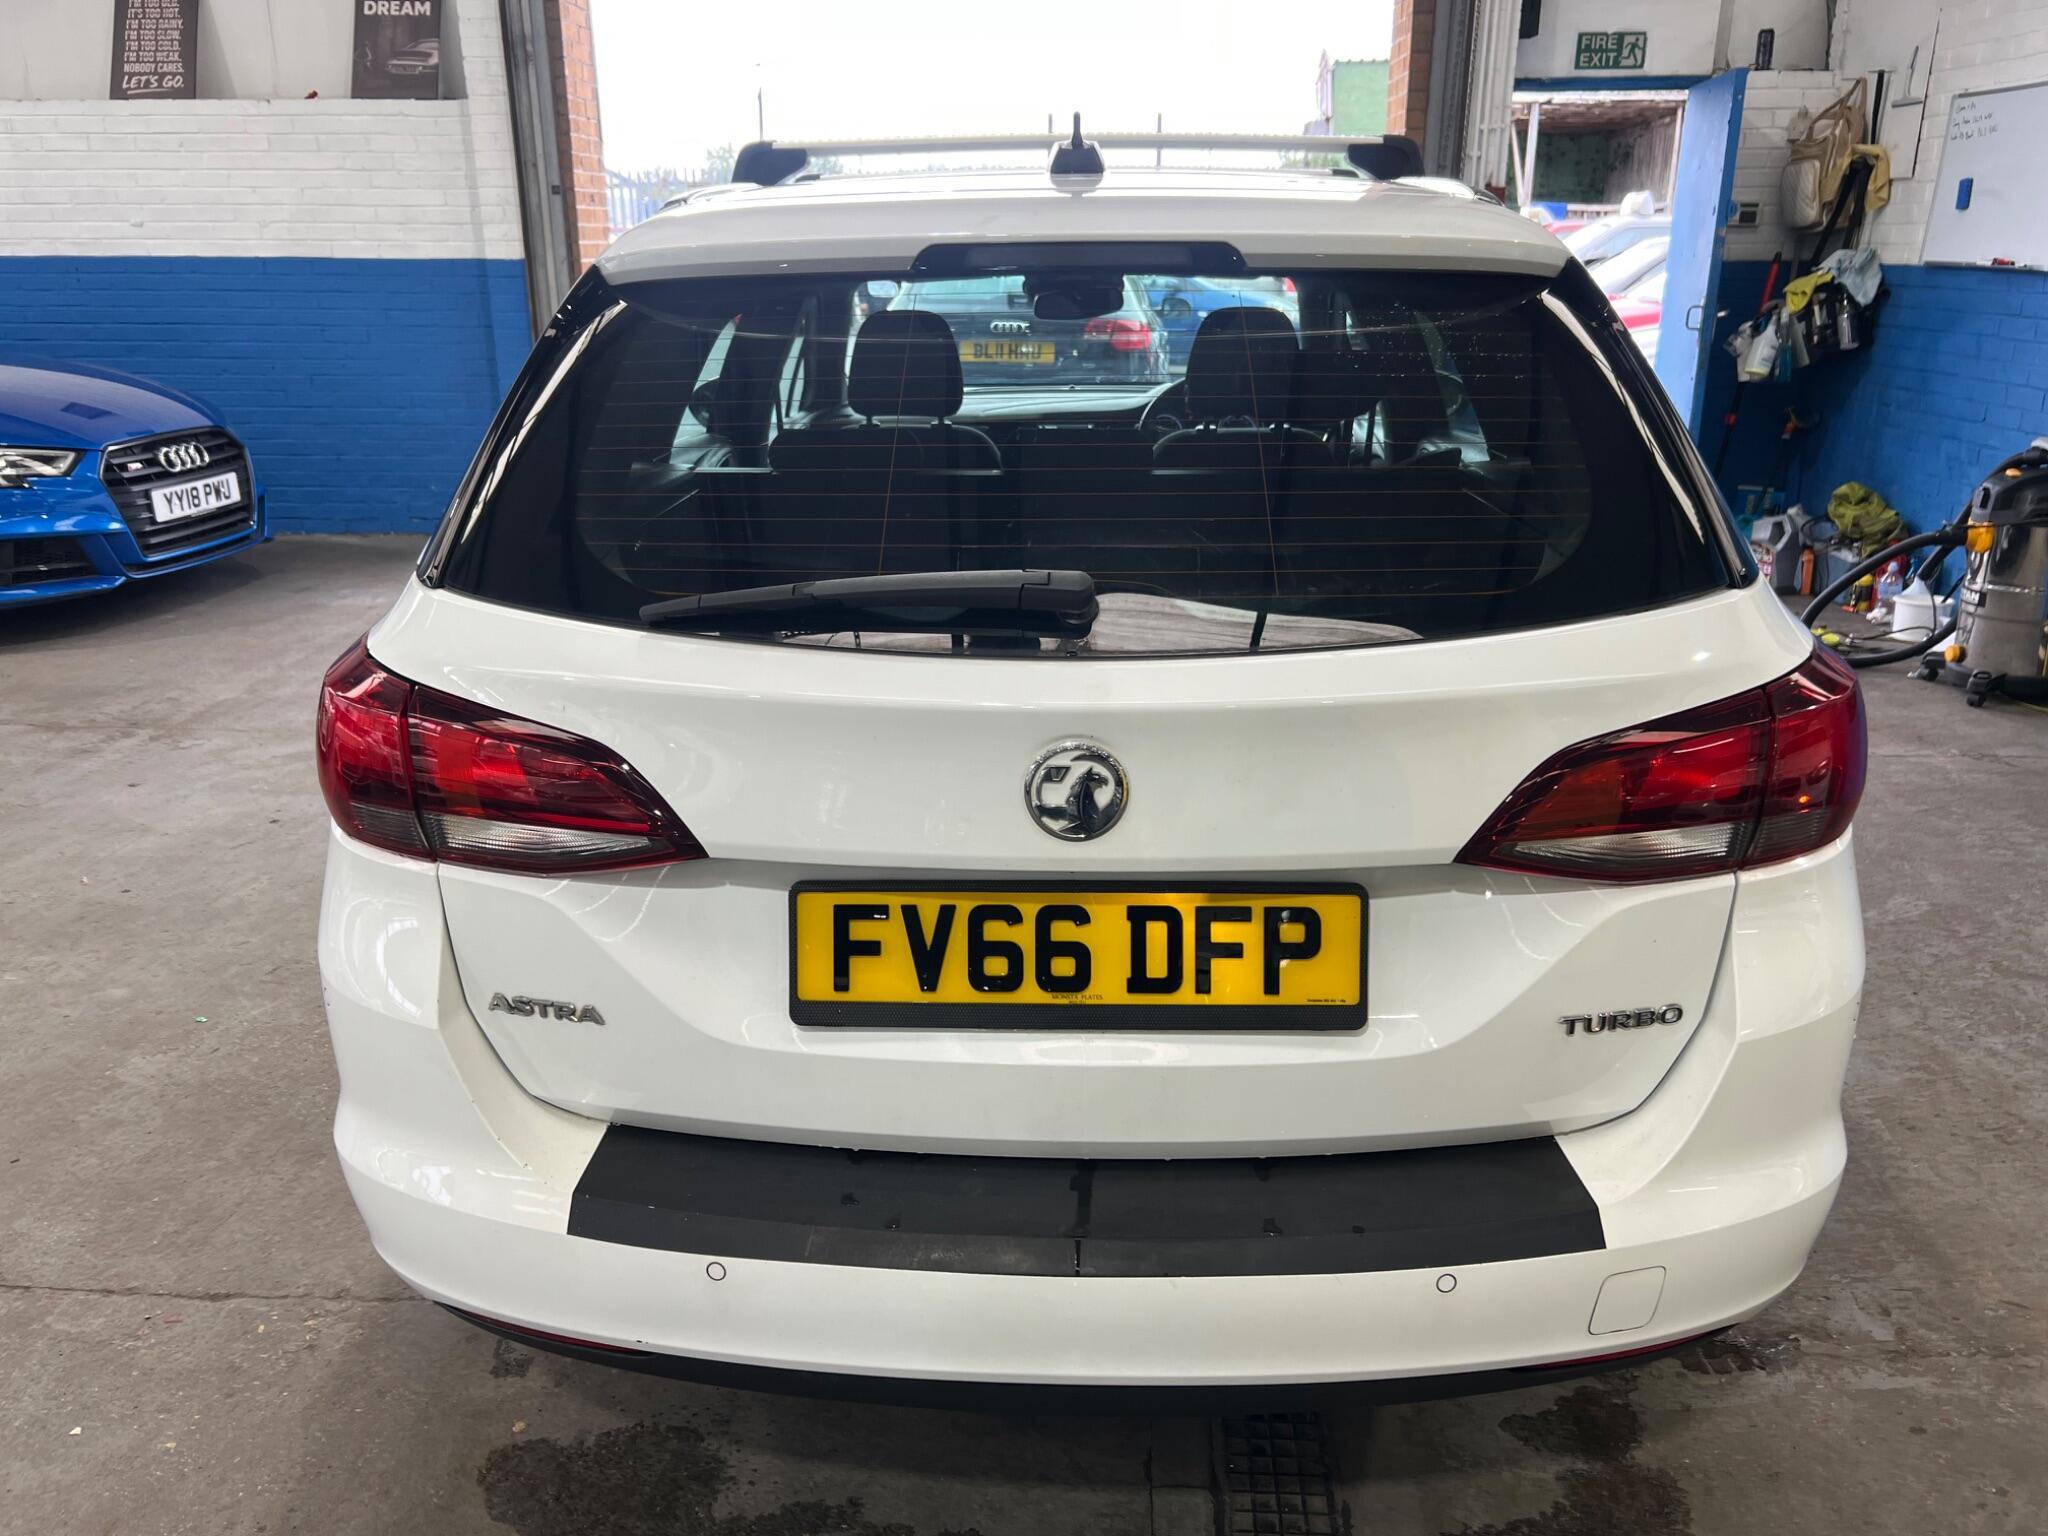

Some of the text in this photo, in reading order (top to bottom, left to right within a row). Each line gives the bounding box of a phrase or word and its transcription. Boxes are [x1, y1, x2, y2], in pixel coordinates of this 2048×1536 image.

[127, 8, 180, 18] IT'S TOO HOT.
[363, 0, 431, 16] DREAM
[141, 19, 157, 29] TOO
[124, 30, 181, 40] I'M TOO SLOW.
[1580, 34, 1618, 49] FIRE
[126, 41, 181, 51] I'M TOO COLD.
[124, 52, 182, 62] I'M TOO WEAK.
[1579, 52, 1617, 67] EXIT
[123, 62, 184, 73] NOBODY CARES.
[122, 75, 184, 88] LET'S GO.
[163, 478, 231, 515] YY18 PWU
[832, 903, 1322, 996] FV66 DFP
[488, 992, 606, 1026] ASTRA
[1558, 1003, 1683, 1036] TURBO
